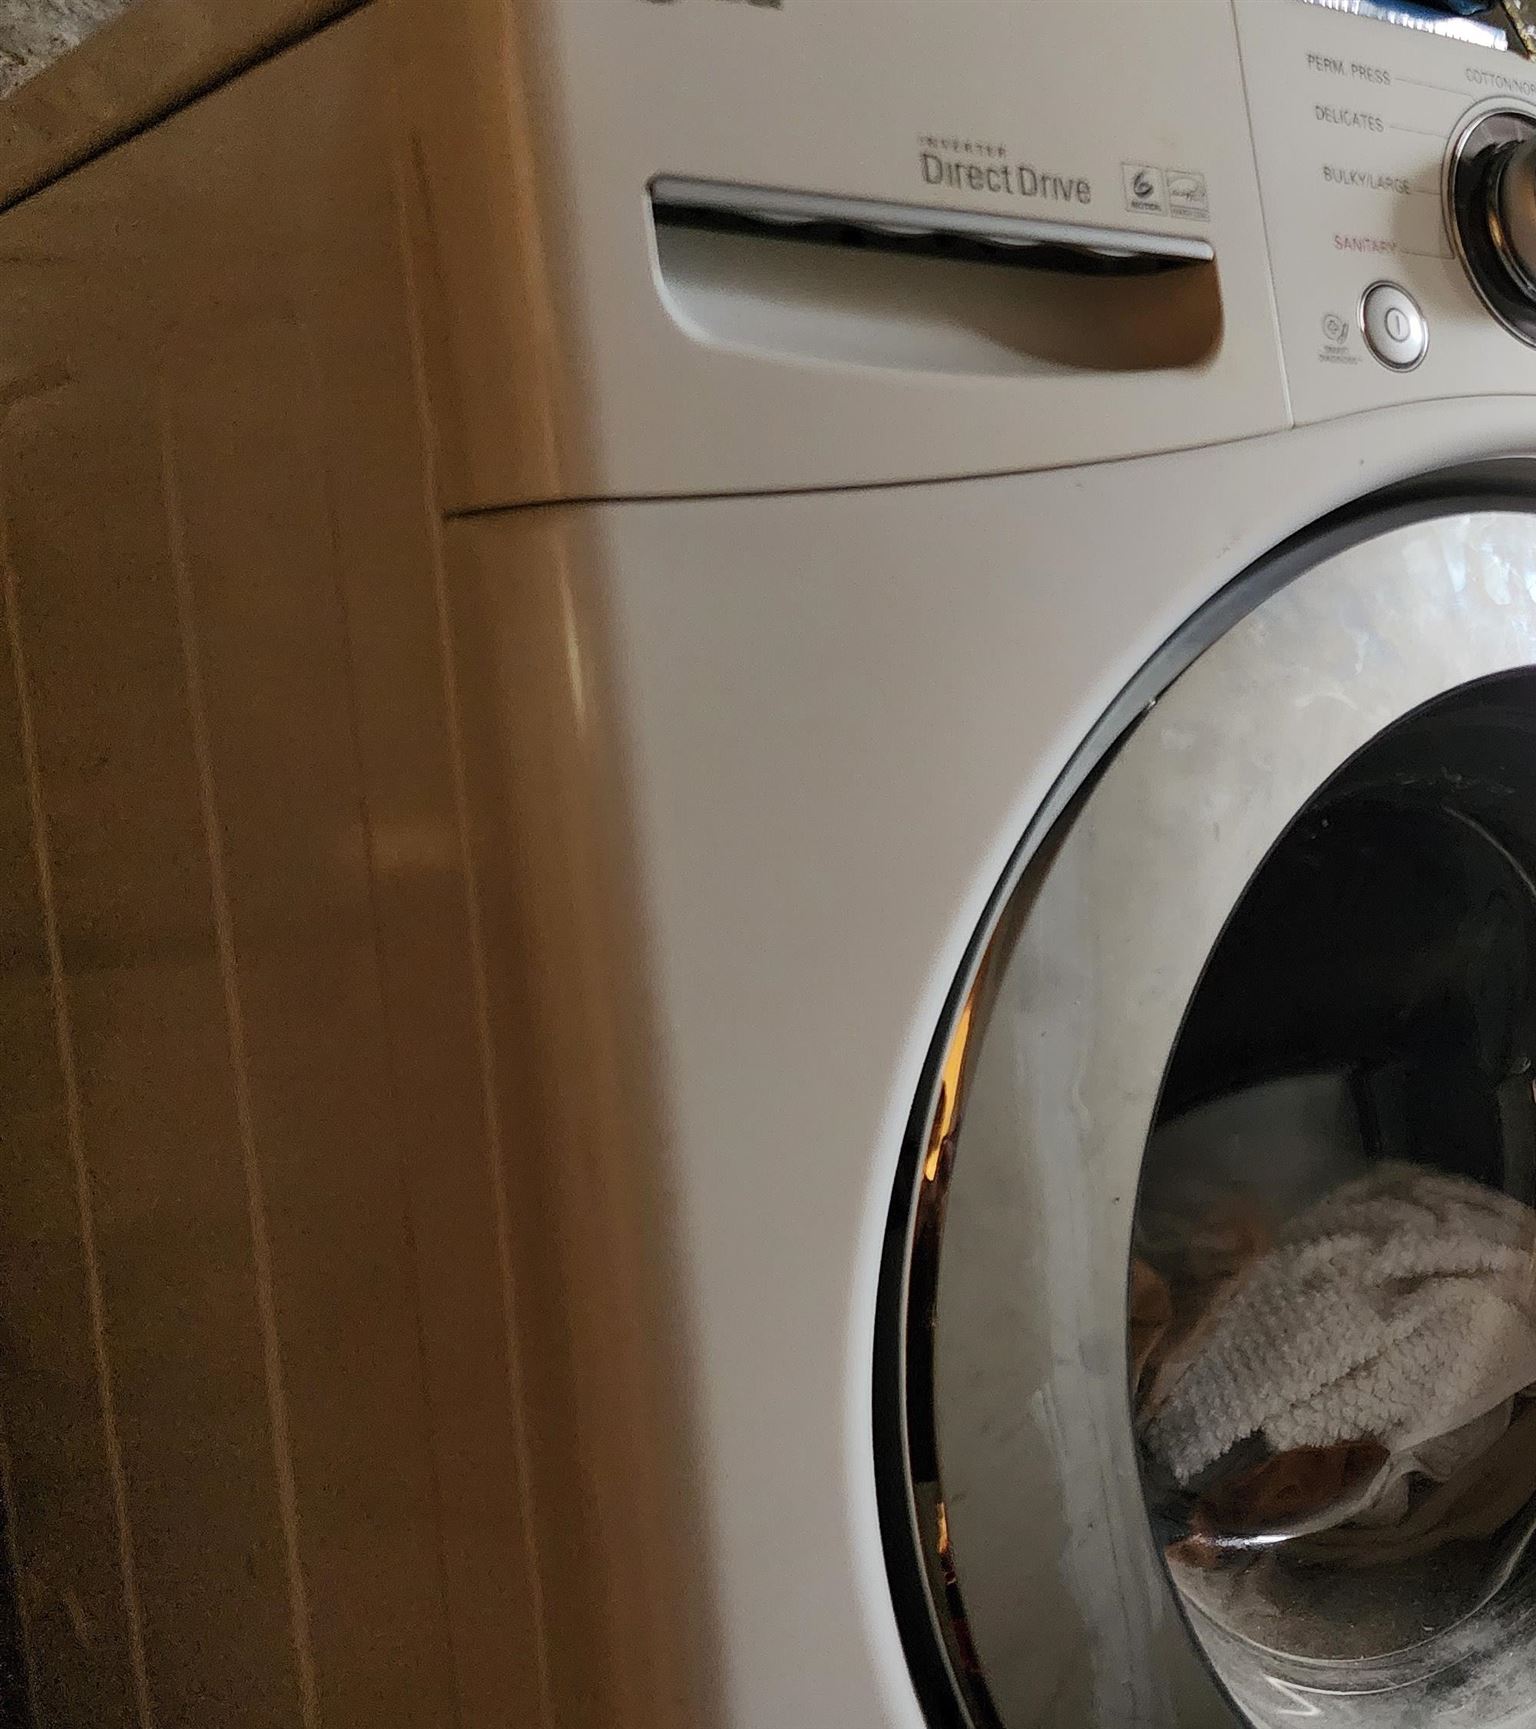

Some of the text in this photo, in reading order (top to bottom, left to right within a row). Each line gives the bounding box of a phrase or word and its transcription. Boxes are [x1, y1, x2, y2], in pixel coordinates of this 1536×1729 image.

[1351, 63, 1391, 86] PRESS
[1315, 105, 1385, 133] DELICATES
[922, 153, 1092, 204] Direct Drive
